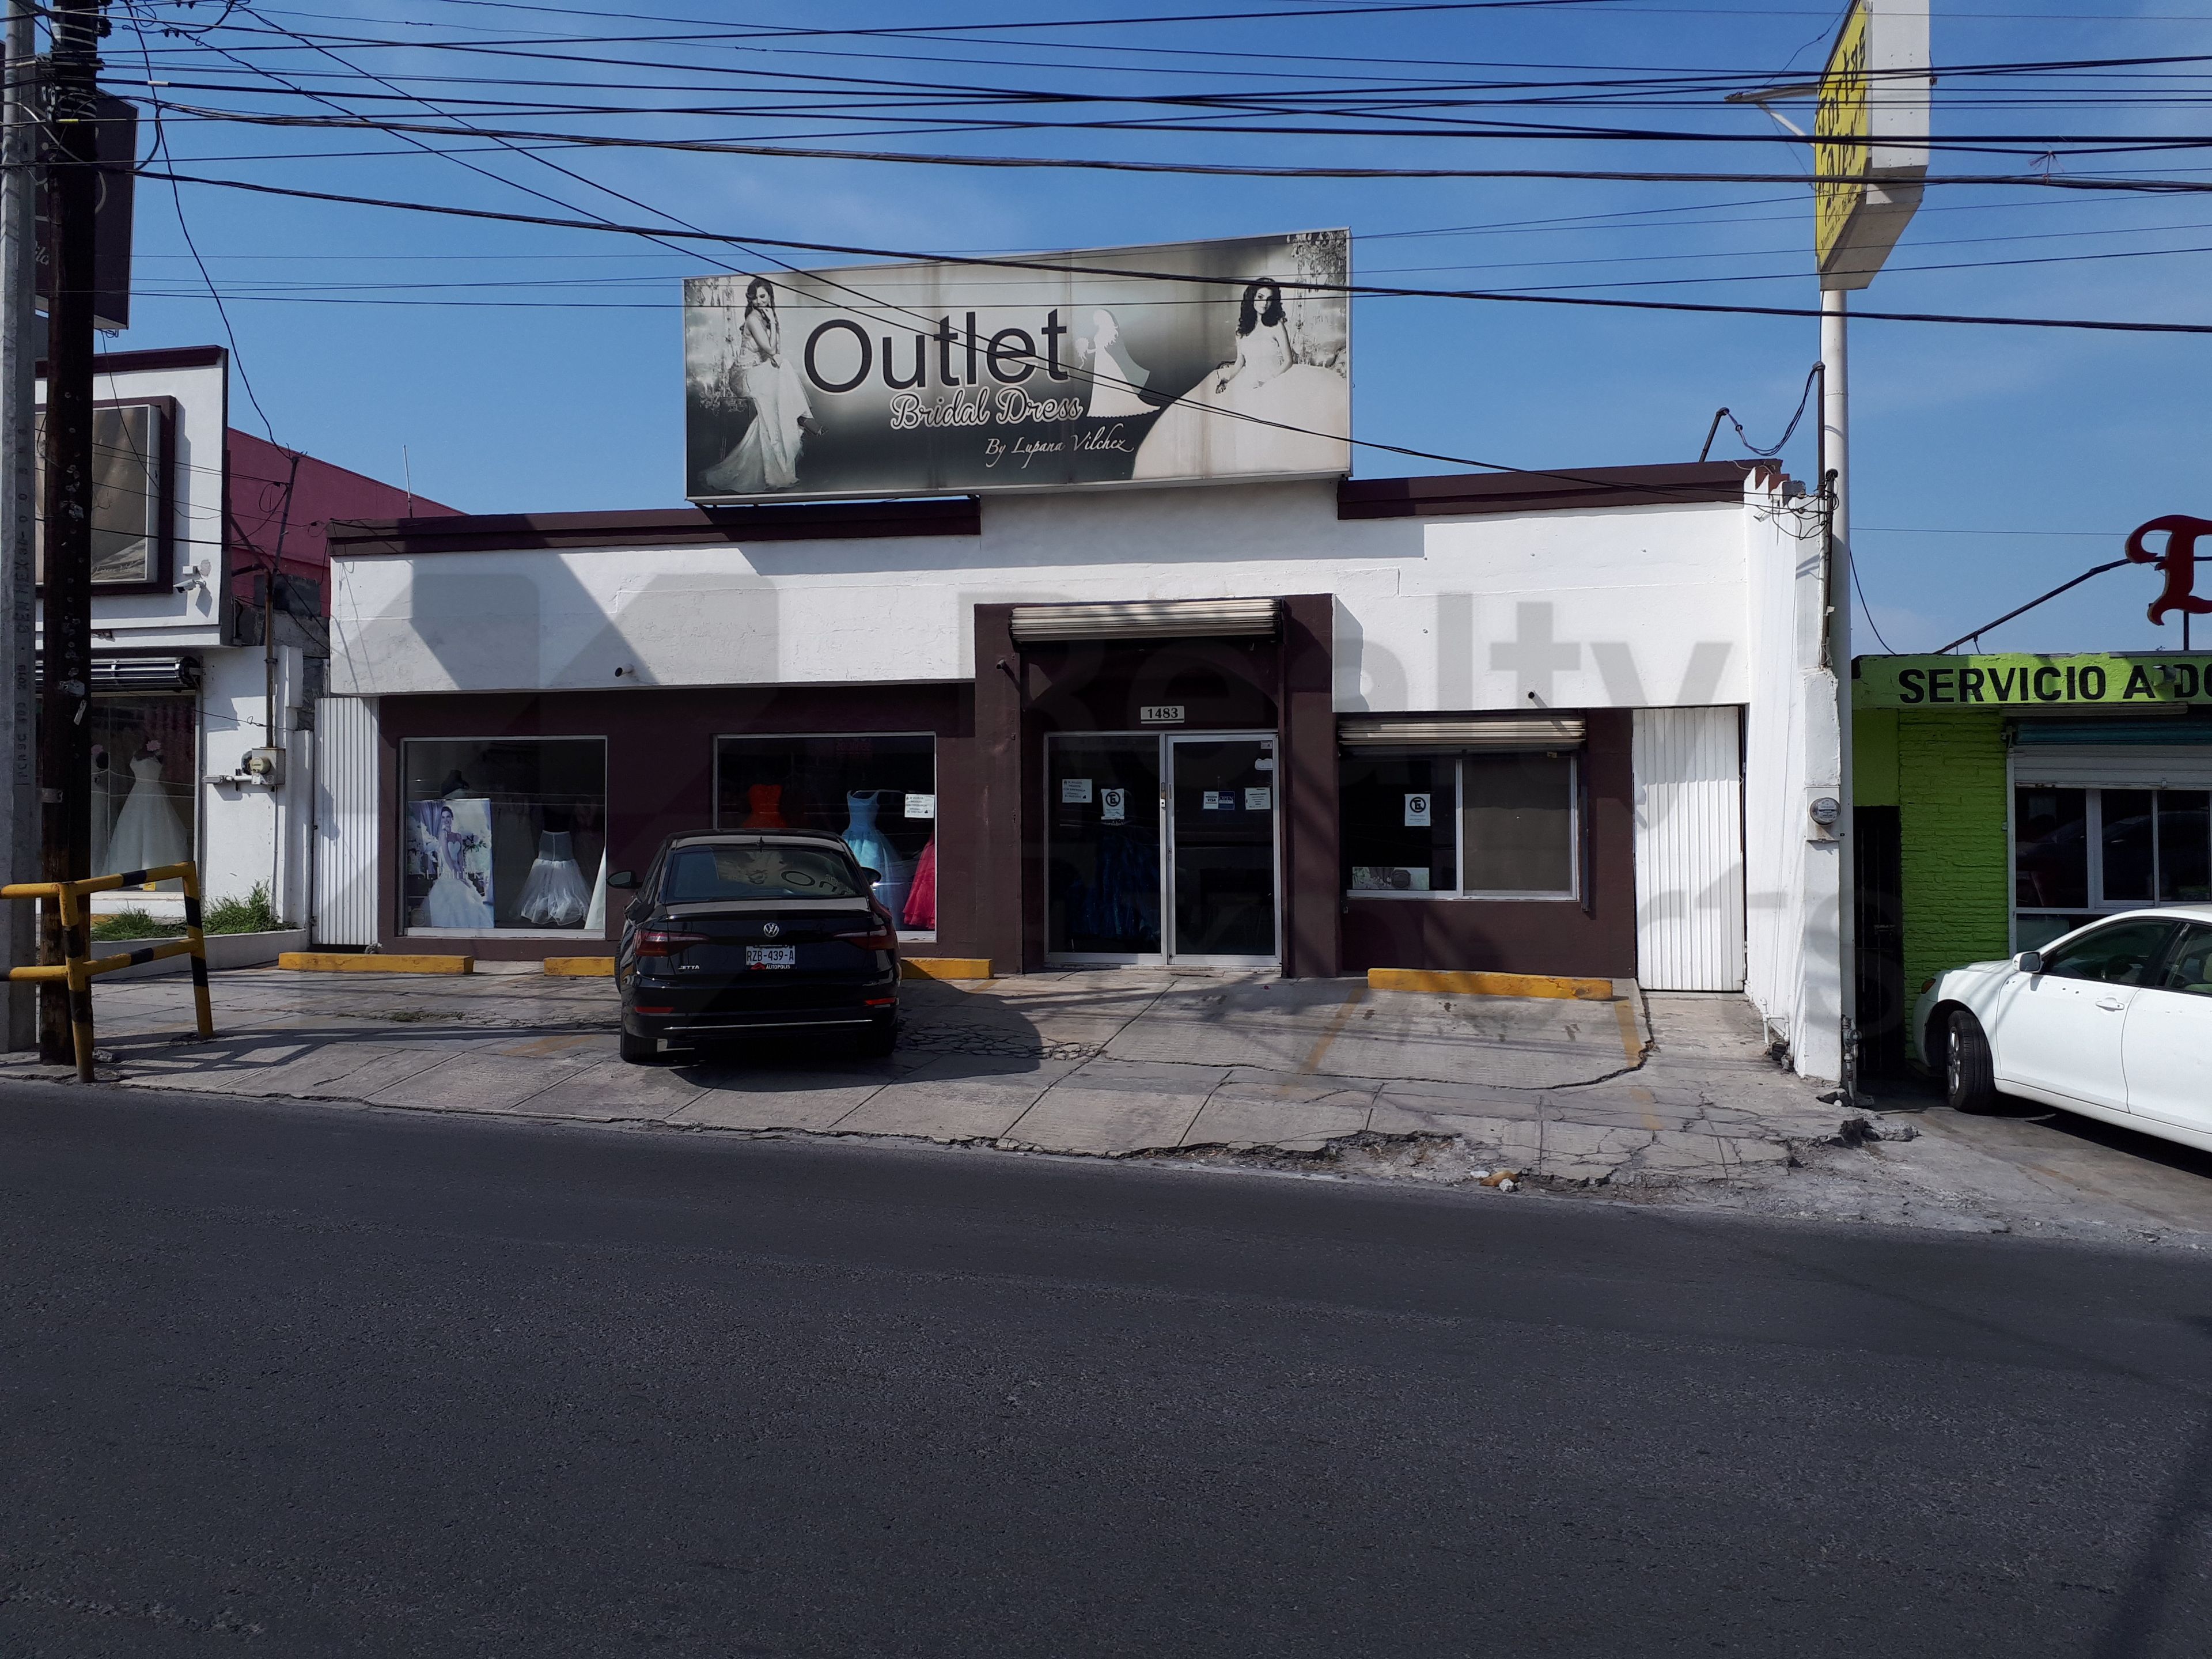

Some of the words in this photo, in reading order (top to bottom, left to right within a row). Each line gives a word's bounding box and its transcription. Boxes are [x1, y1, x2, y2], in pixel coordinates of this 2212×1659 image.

[804, 308, 1069, 393] Outlet
[891, 387, 990, 429] Bridal
[996, 386, 1084, 424] Dress
[985, 437, 1007, 468] By
[1011, 437, 1066, 469] Lupana
[1070, 423, 1134, 452] Vilchez
[1899, 666, 2106, 703] SERVICIO
[2123, 665, 2156, 699] A
[1147, 707, 1178, 718] 1483
[747, 950, 794, 961] RZB-439-A
